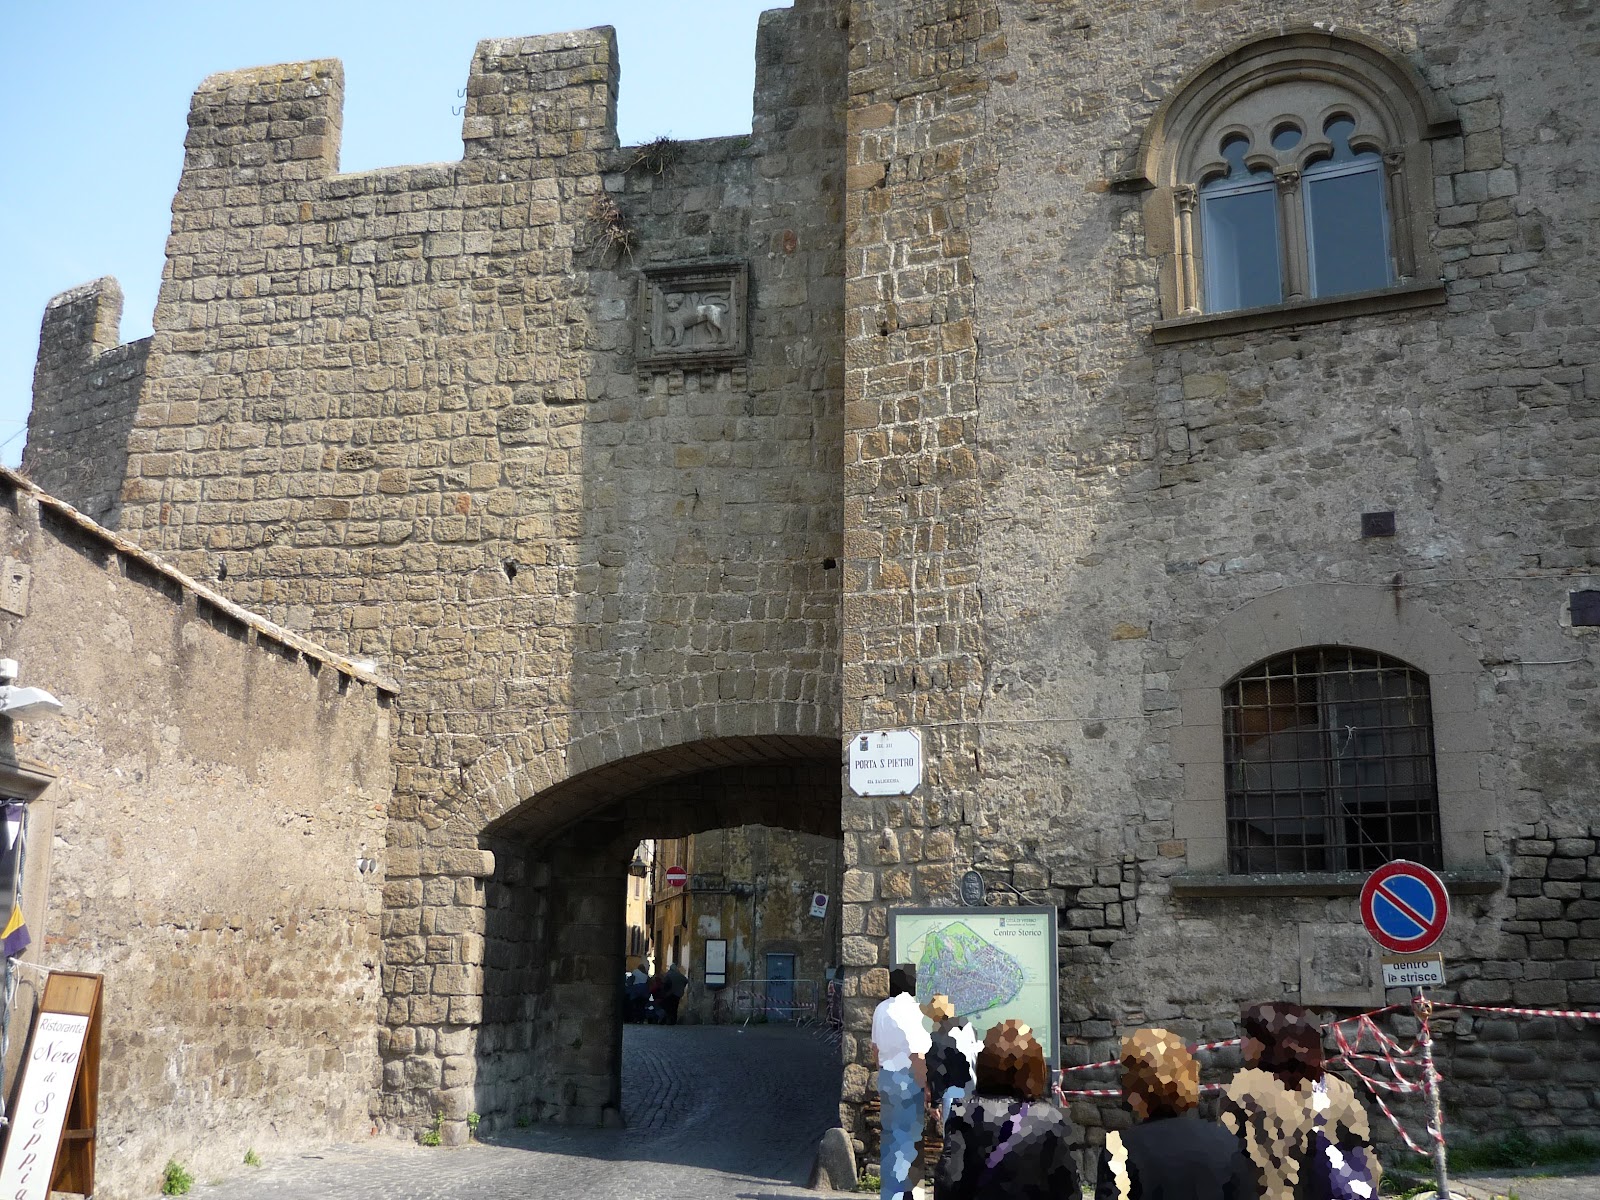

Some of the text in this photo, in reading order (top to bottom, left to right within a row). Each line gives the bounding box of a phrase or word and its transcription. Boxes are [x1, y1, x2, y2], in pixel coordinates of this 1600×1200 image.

[855, 759, 877, 769] PORTA
[887, 757, 914, 768] PIETRO
[993, 928, 1042, 936] Centro Storico
[1400, 971, 1437, 982] strisce
[40, 1018, 85, 1034] Ristorante
[33, 1041, 77, 1064] Nero
[43, 1073, 57, 1083] di
[15, 1092, 55, 1200] Seppia
